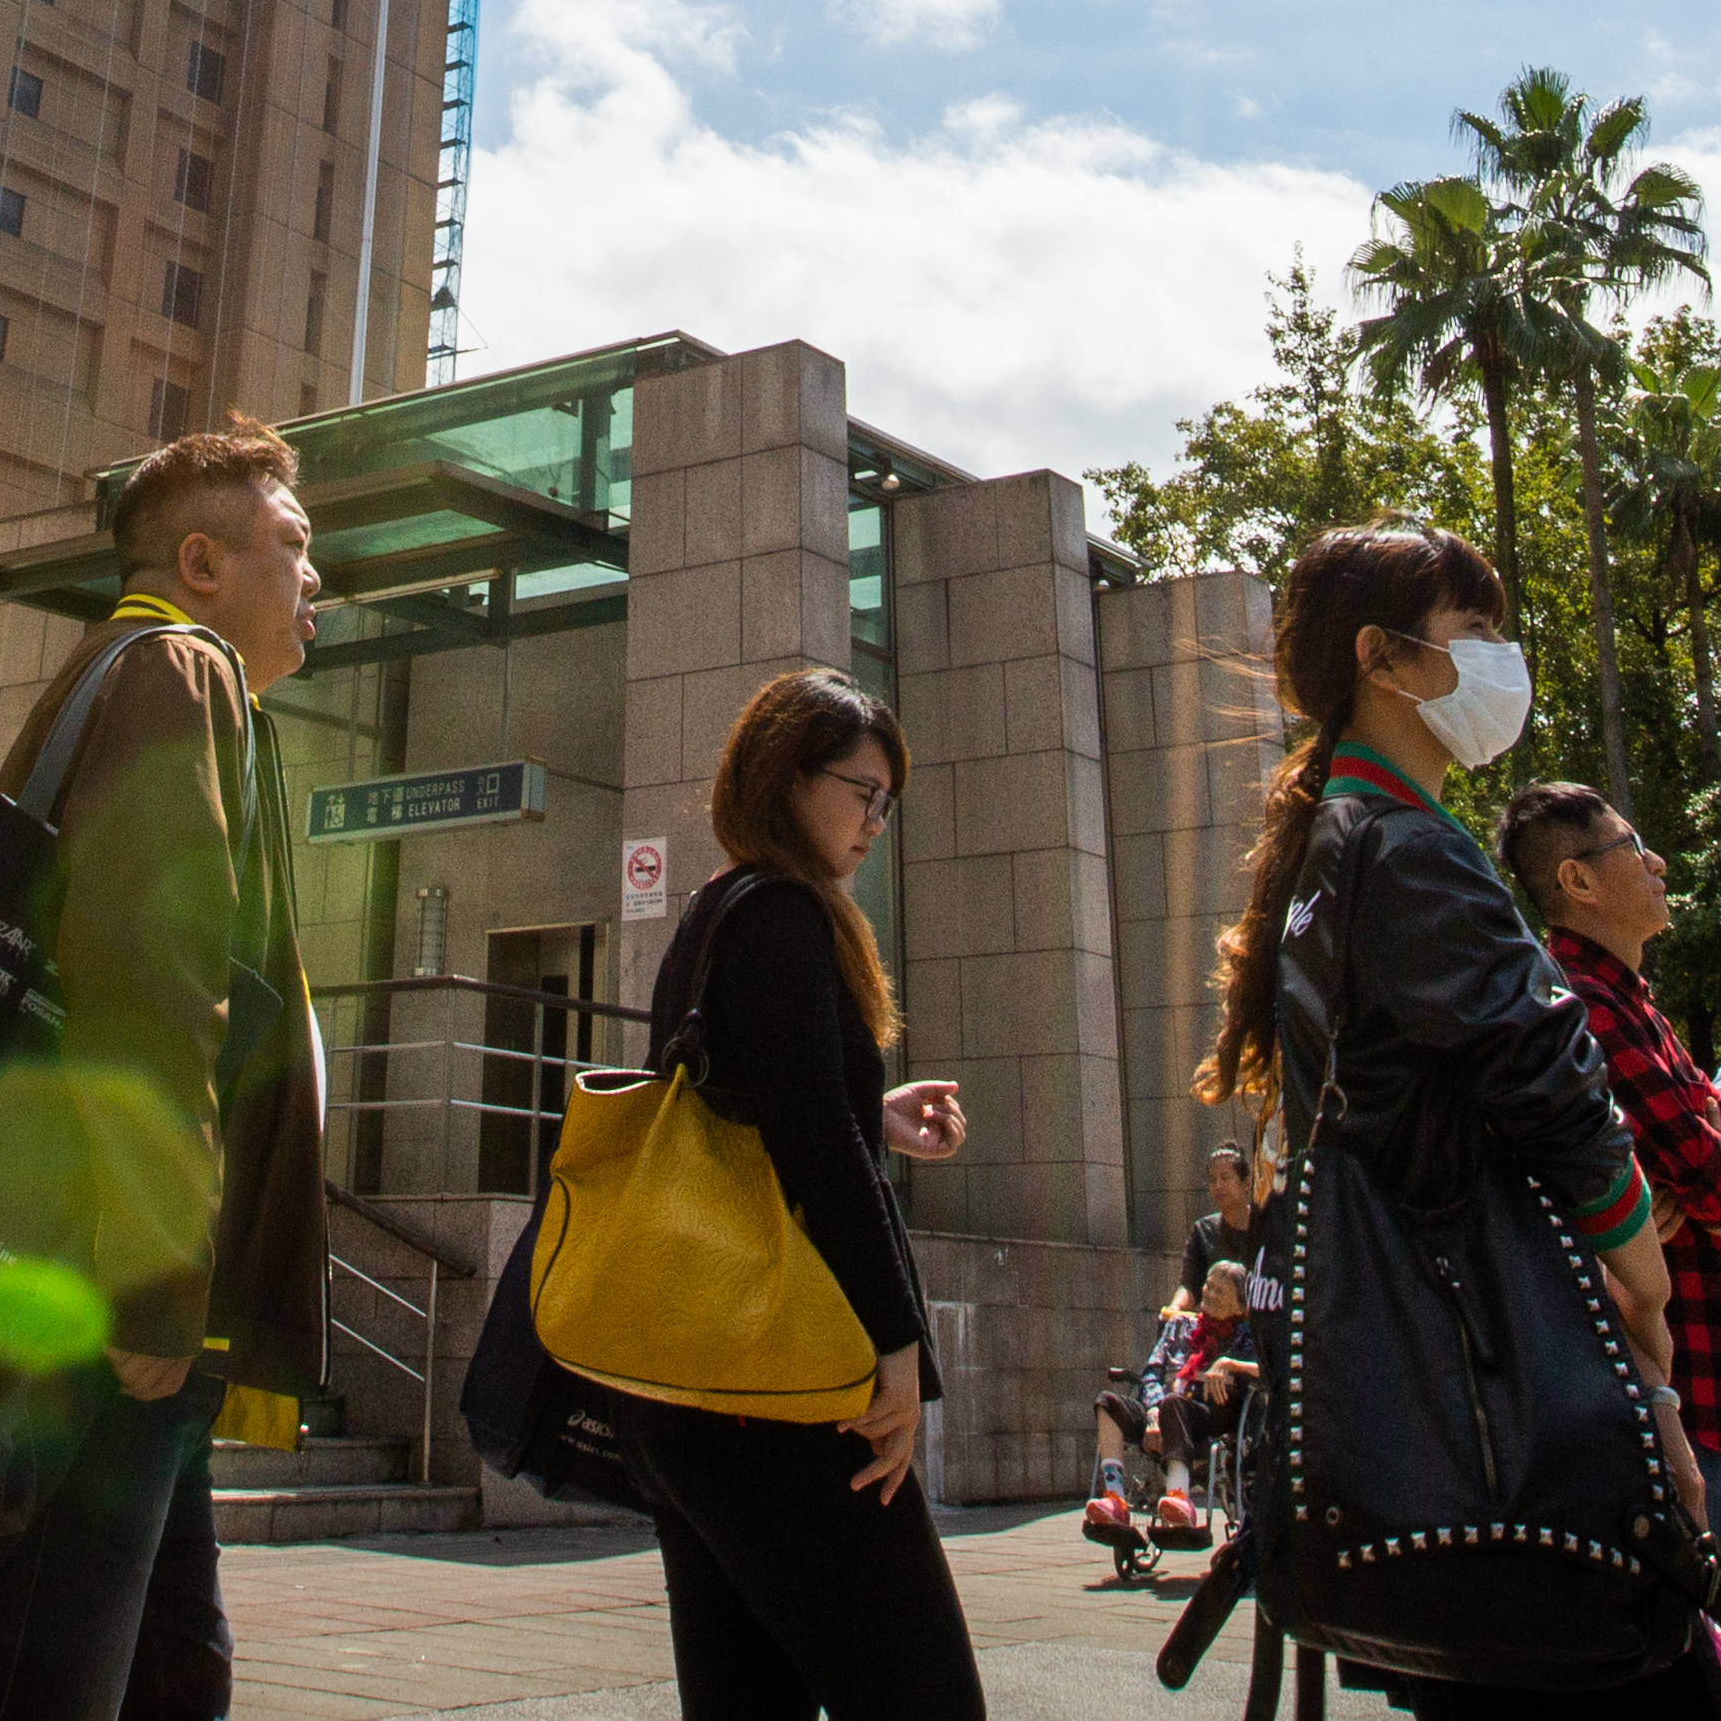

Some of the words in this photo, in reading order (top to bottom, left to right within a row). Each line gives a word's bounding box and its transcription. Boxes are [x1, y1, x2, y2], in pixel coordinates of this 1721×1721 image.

[406, 779, 466, 800] UNDERPASS
[408, 797, 461, 818] ELEVATOR
[477, 795, 500, 810] EXIT
